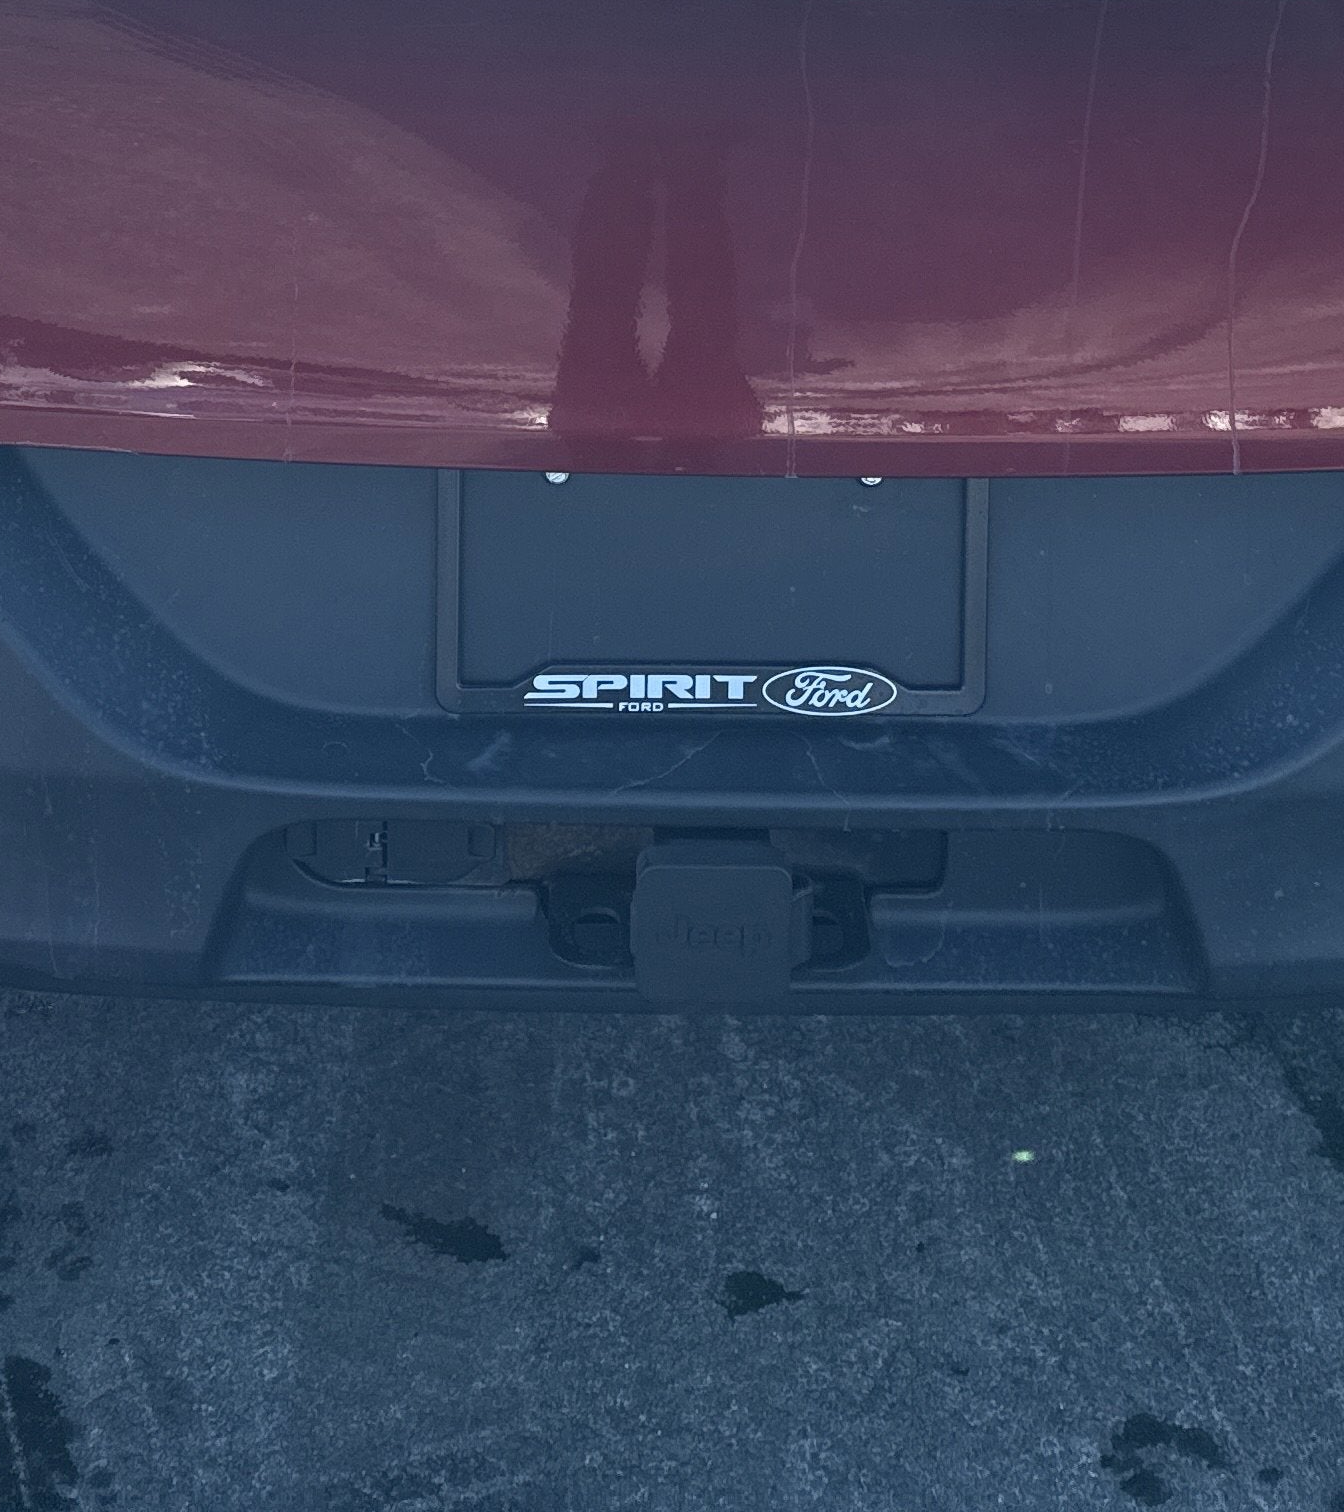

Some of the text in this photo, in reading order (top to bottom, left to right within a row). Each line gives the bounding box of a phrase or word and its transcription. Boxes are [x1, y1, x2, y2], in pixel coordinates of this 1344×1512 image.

[523, 671, 872, 709] SPIRIT Ford
[617, 701, 664, 713] FORD
[655, 913, 773, 958] Jeep
